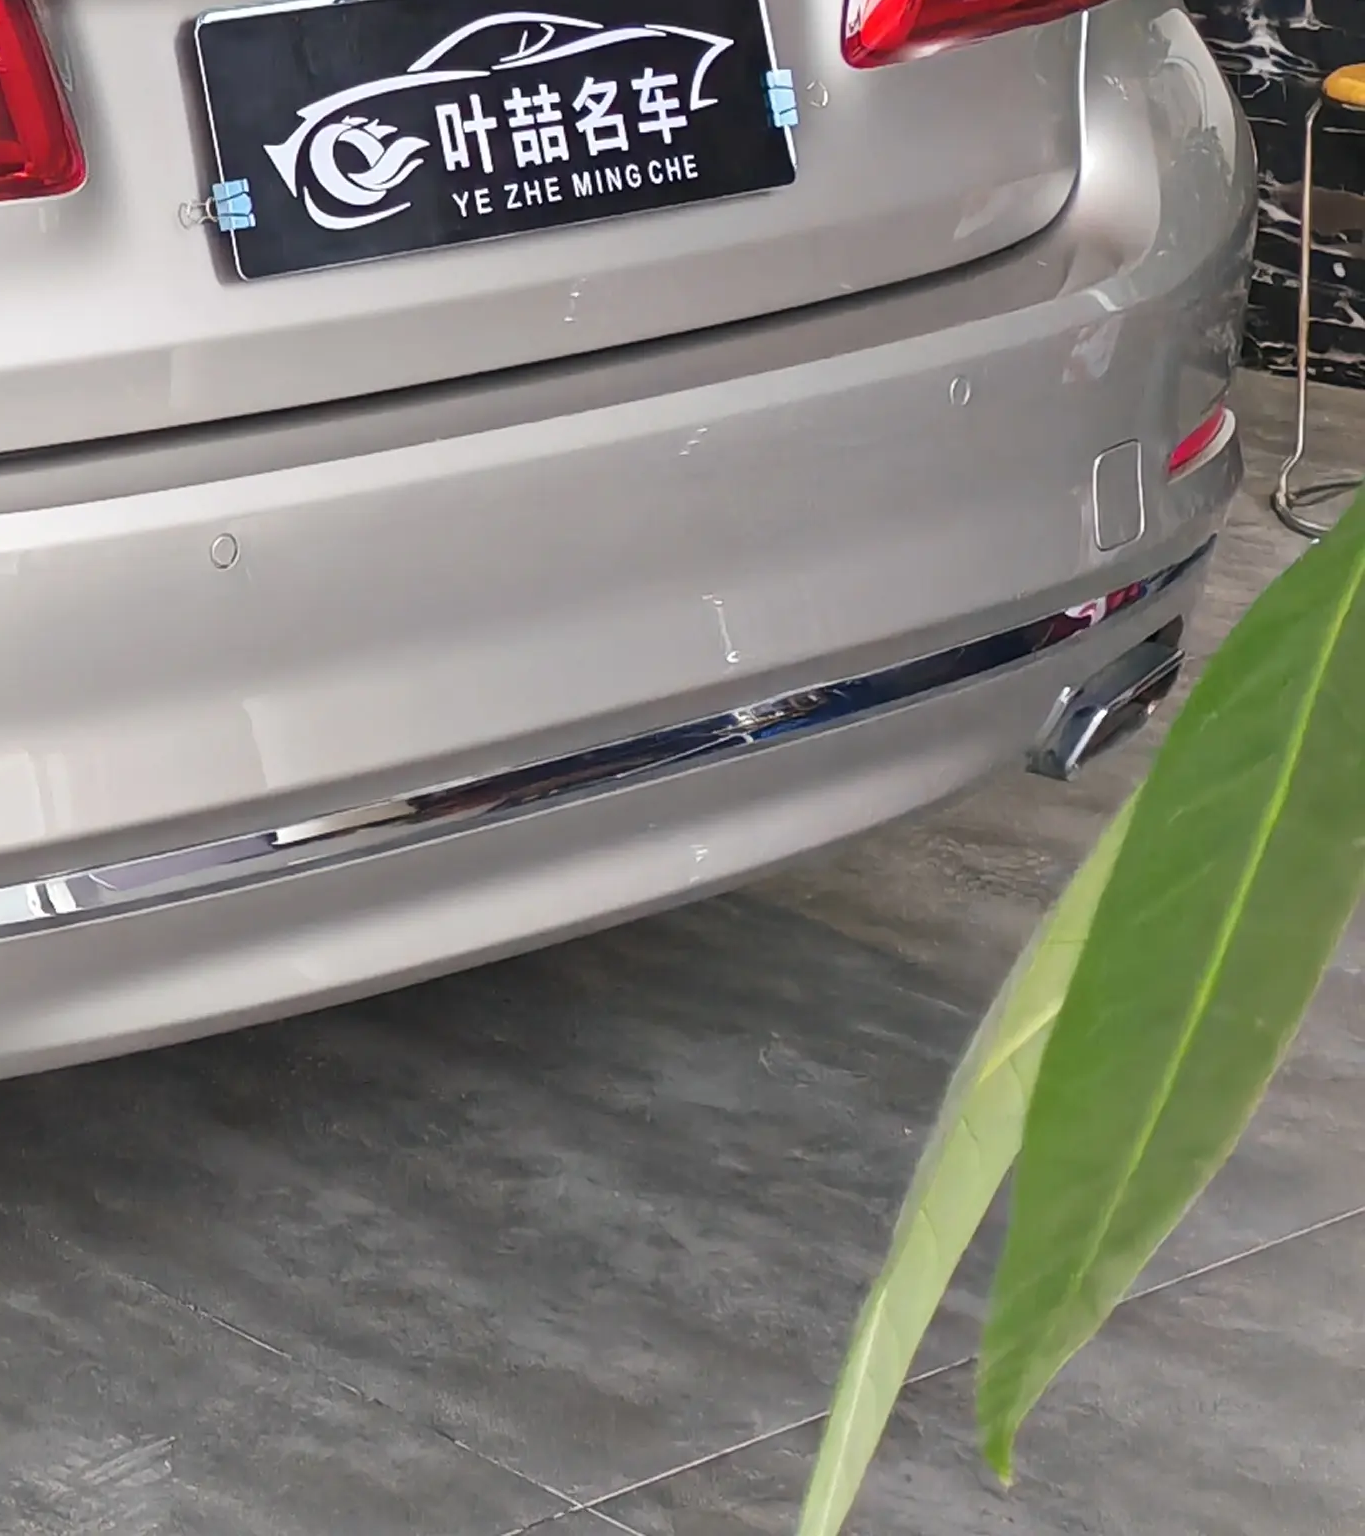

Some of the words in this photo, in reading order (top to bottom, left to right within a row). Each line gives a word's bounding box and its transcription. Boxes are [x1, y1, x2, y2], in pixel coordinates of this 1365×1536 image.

[434, 67, 689, 175] 叶喆名车
[451, 187, 494, 218] YE
[503, 176, 563, 210] ZHE
[571, 163, 643, 199] MING
[648, 154, 700, 185] CHE
